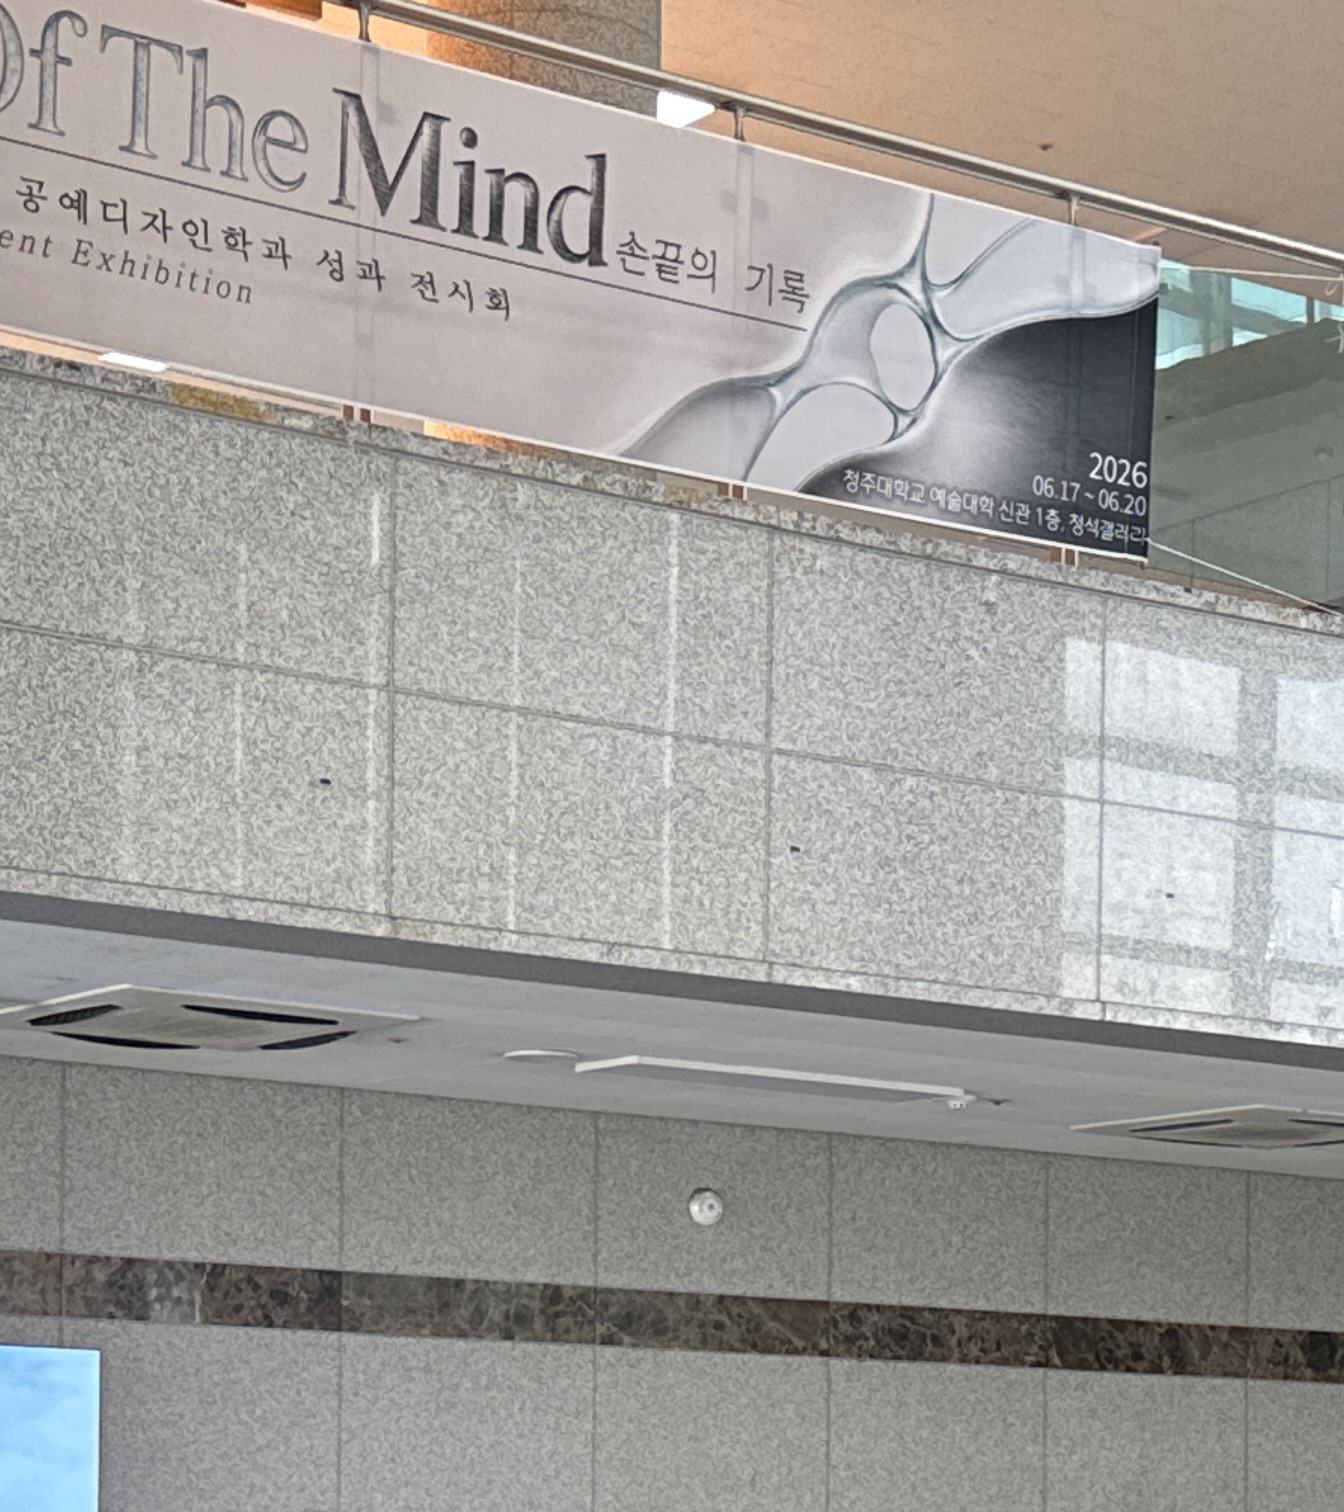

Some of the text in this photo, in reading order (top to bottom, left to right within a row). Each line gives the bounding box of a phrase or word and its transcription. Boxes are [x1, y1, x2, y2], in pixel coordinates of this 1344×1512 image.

[99, 24, 308, 193] The
[328, 87, 609, 267] Mind
[16, 175, 293, 271] 공예디자인학과
[316, 249, 387, 293] 성과
[410, 271, 511, 321] 전시회
[70, 238, 253, 304] Exhibition
[615, 230, 811, 314] 손끝의 기록
[842, 468, 926, 504] 청주대학교
[929, 486, 996, 520] 예술대학
[998, 500, 1031, 526] 신관
[1031, 474, 1082, 503] 06.17
[1097, 488, 1148, 517] 06.20
[1088, 451, 1148, 489] 2026
